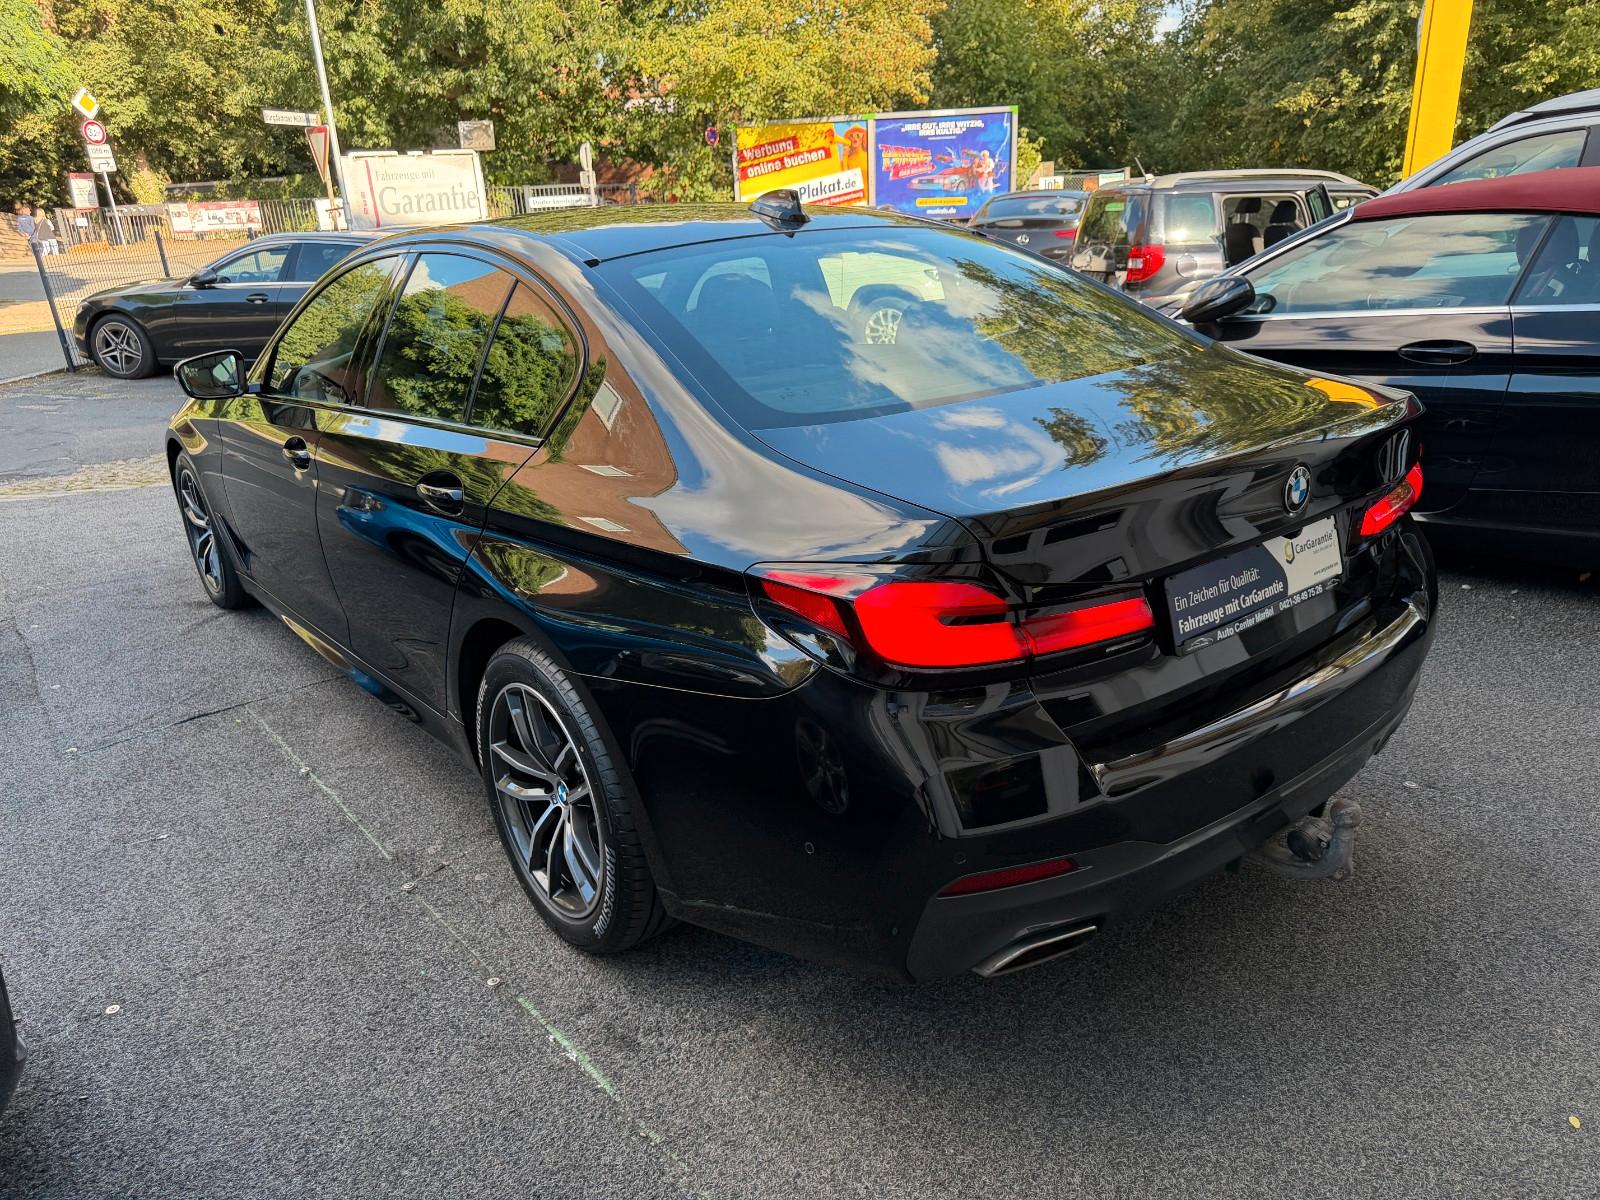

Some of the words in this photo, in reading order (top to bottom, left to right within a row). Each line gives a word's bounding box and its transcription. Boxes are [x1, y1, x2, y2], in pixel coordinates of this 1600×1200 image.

[742, 139, 794, 160] Werbung
[747, 162, 782, 178] online
[783, 149, 826, 168] buchen
[375, 170, 418, 183] Fahrzeuge
[421, 169, 435, 180] mit
[379, 182, 477, 216] Garantie
[1295, 531, 1333, 554] CarGarantie
[1174, 596, 1188, 612] Ein
[1188, 586, 1219, 605] Zeichen
[1218, 580, 1230, 595] für
[1230, 568, 1261, 590] Qualität:
[1178, 607, 1225, 635] Fahrzeuge
[1225, 600, 1240, 616] mit
[1240, 579, 1284, 609] CarGarantie
[1216, 628, 1234, 641] Auto
[1234, 616, 1255, 632] Center
[1308, 588, 1316, 599] 75
[1315, 585, 1323, 595] 26
